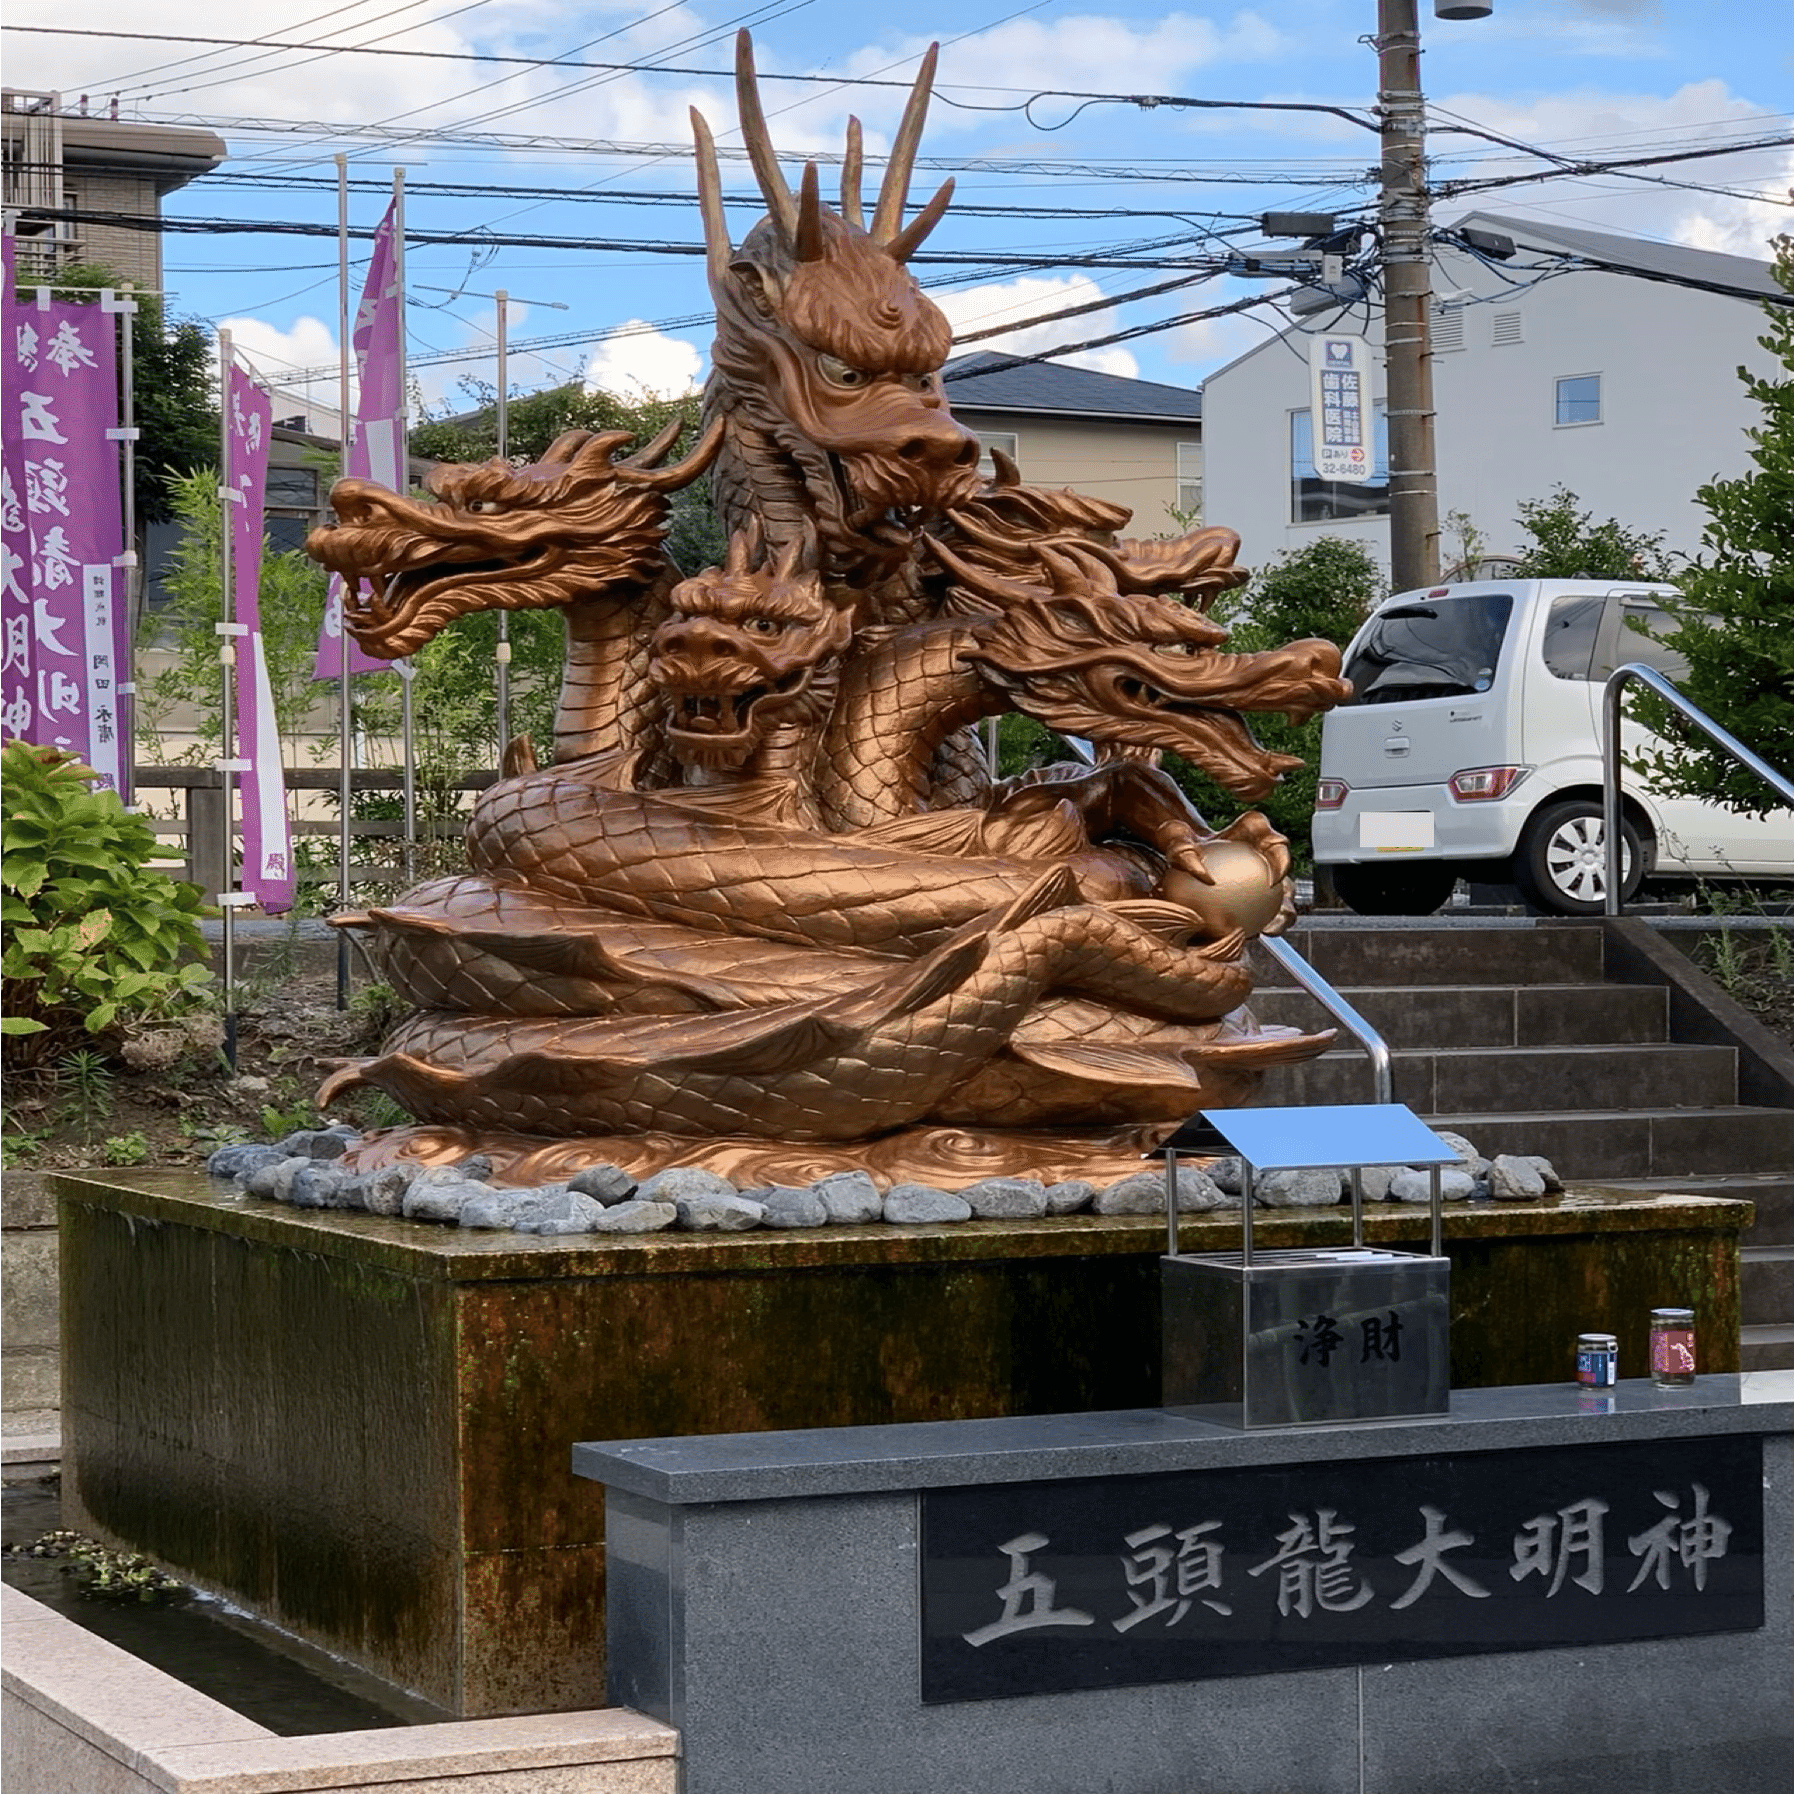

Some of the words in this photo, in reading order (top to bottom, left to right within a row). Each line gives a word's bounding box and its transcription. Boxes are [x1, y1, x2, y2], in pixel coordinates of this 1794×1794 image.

[1323, 373, 1342, 443] 歯科医院
[1322, 462, 1366, 475] 32-6480
[1294, 1310, 1404, 1367] 浄財
[962, 1481, 1734, 1648] 五頭龍大明神
